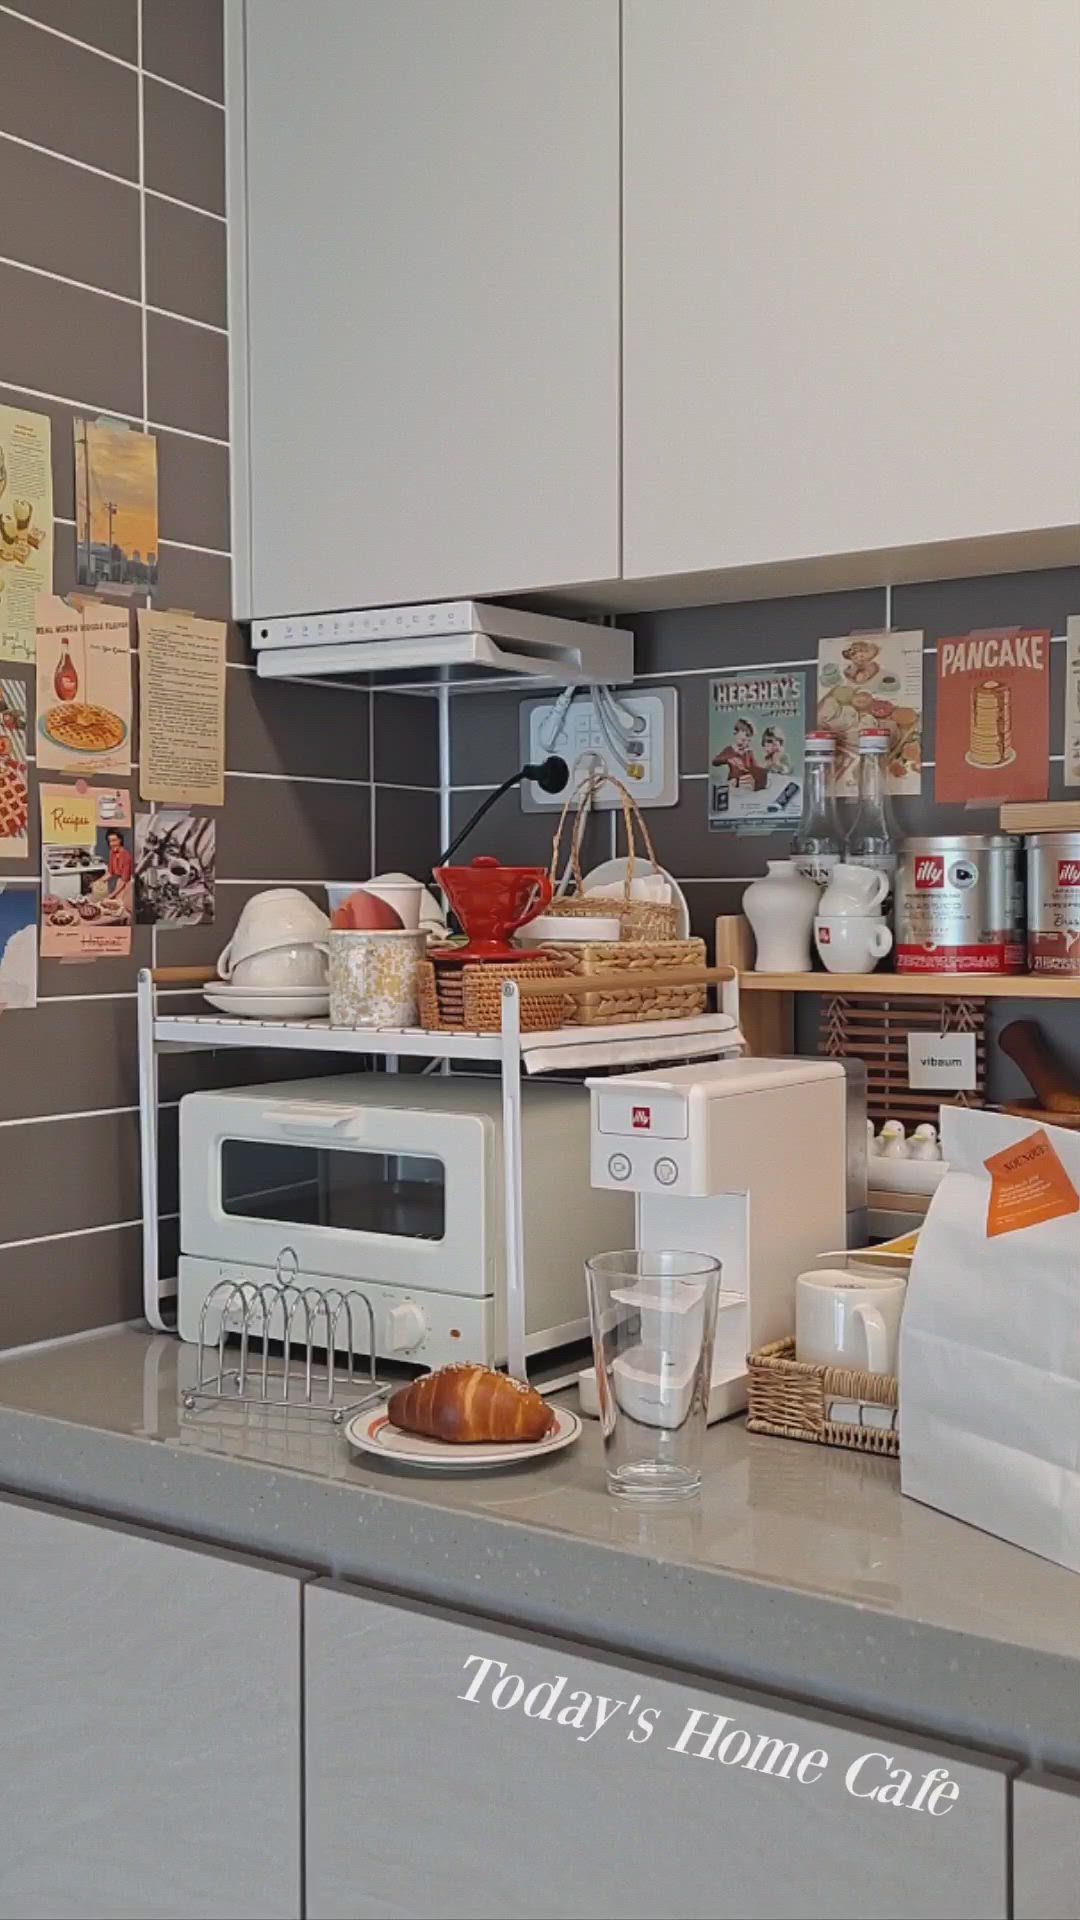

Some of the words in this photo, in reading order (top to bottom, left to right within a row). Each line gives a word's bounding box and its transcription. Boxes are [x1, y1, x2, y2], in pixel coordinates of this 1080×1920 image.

[941, 636, 1044, 678] PANCAKE
[715, 679, 801, 704] HERSHEY'S
[50, 807, 91, 831] Recipes
[917, 860, 943, 886] illy
[920, 1057, 963, 1067] vibaum
